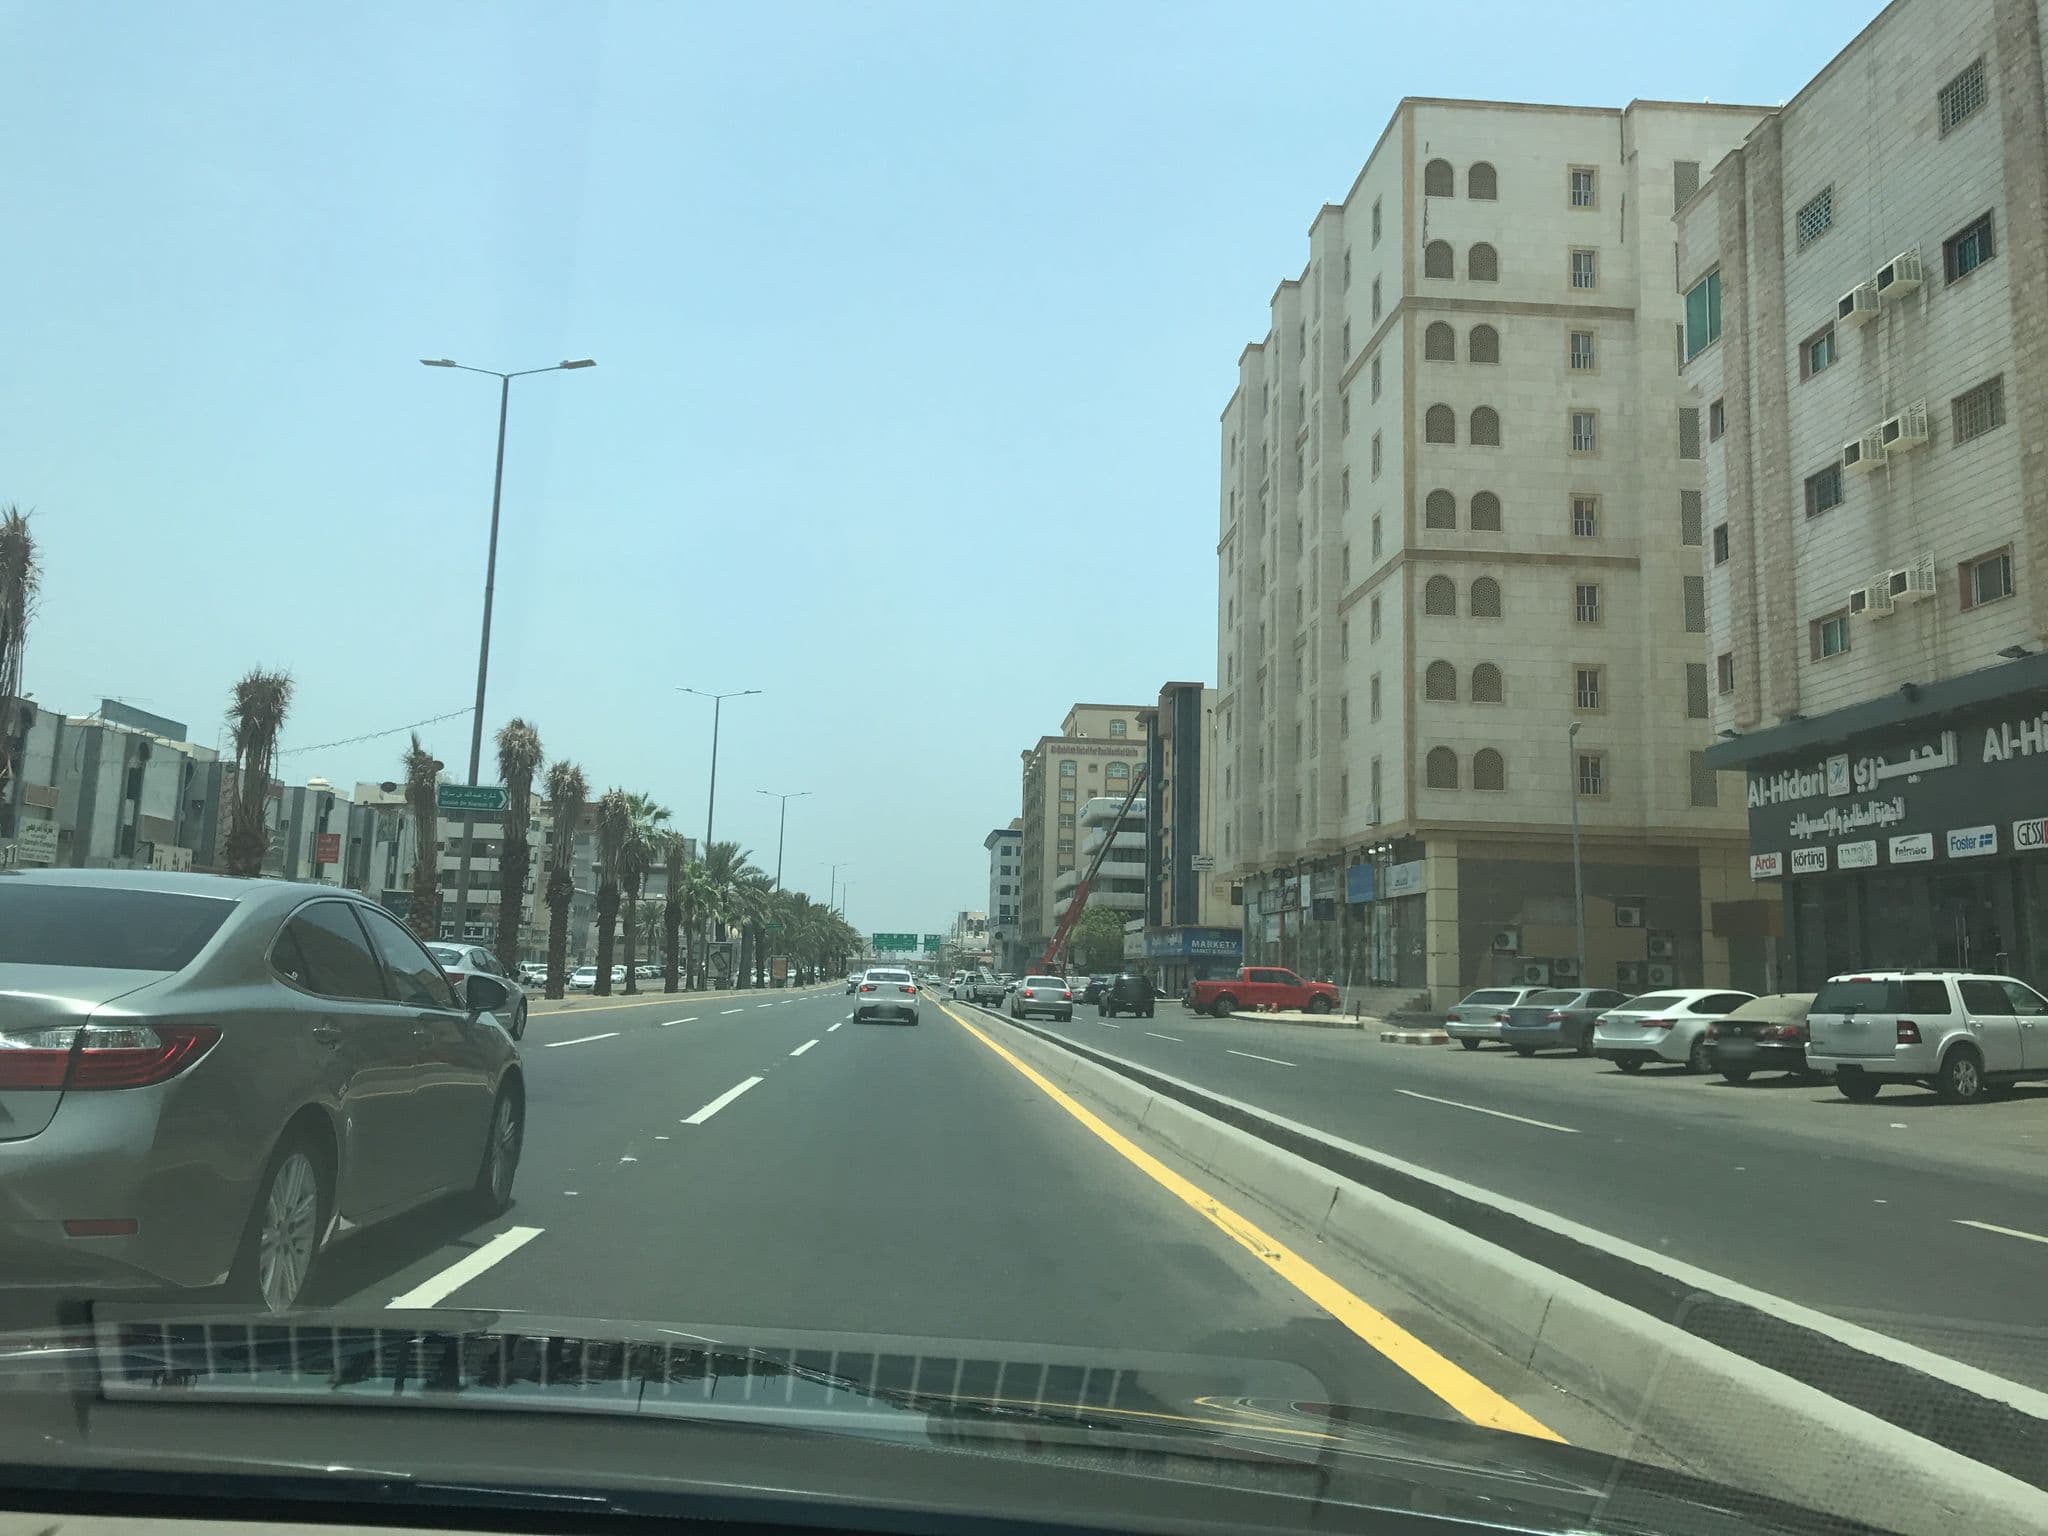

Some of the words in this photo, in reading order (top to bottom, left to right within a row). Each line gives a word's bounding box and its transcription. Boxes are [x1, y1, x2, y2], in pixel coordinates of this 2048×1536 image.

[1854, 730, 1958, 793] الحيدري
[1748, 762, 1825, 808] Al-Hidari
[2017, 820, 2044, 846] GESSI
[1950, 835, 1977, 851] Foster
[1755, 855, 1777, 871] Arda
[1793, 850, 1825, 869] körting
[1191, 939, 1237, 949] MARKETY
